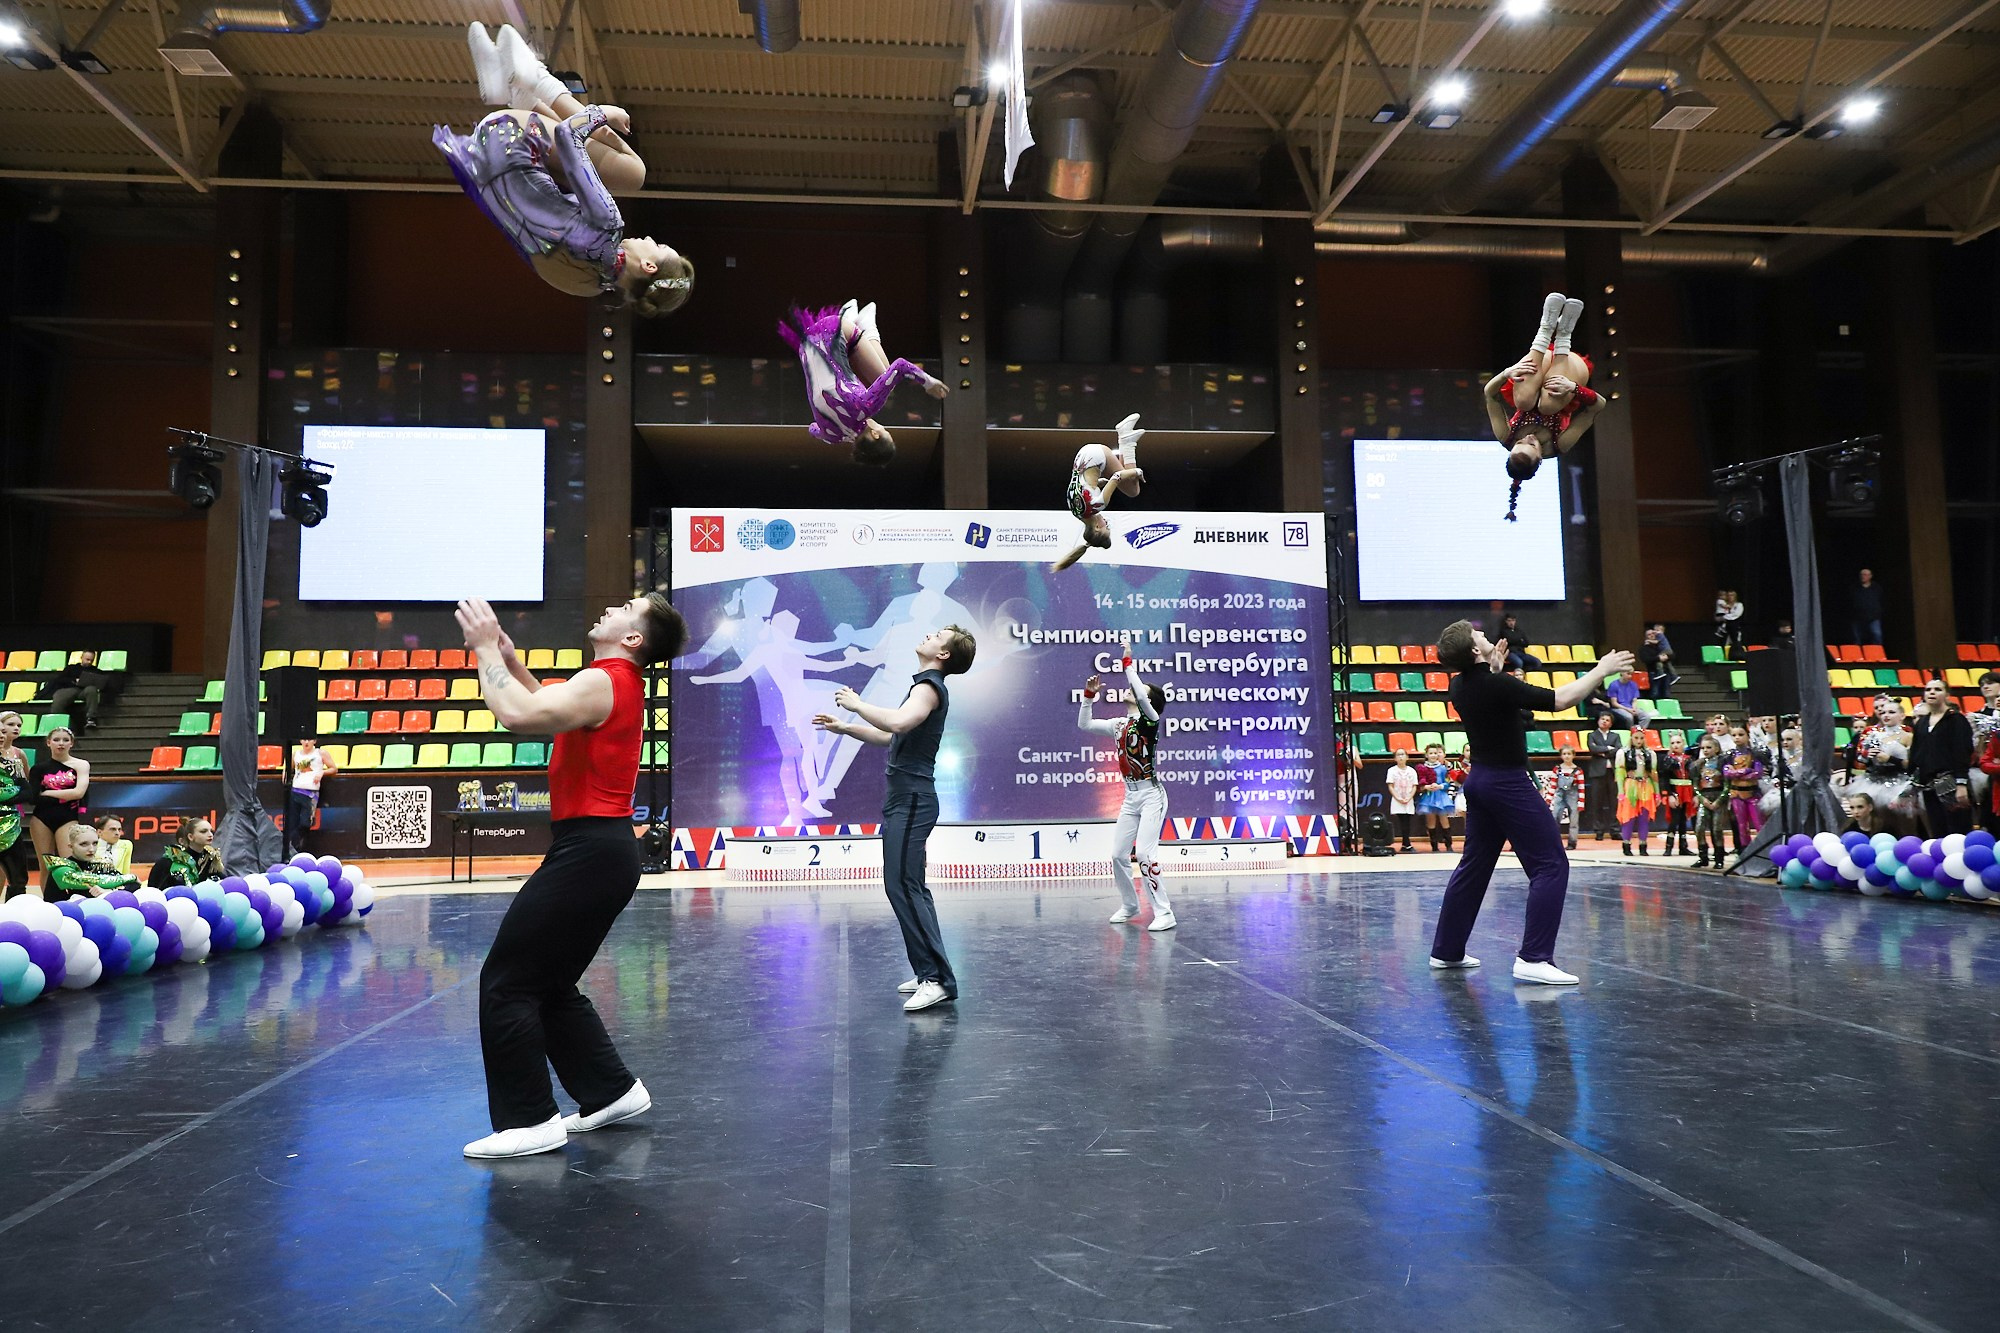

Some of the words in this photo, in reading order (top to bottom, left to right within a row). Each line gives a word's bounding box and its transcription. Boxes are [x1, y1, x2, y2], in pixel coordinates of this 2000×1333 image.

[996, 534, 1058, 543] ФЕДЕРАЦИЯ
[1193, 531, 1269, 543] ДНЕВНИК
[1287, 527, 1304, 542] 78
[1093, 593, 1114, 608] 14
[1127, 593, 1145, 608] 15
[1149, 594, 1220, 612] октября
[1223, 593, 1265, 608] 2023
[1268, 597, 1306, 611] года
[1012, 623, 1144, 644] Чемпионат
[1150, 628, 1163, 643] и
[1169, 622, 1308, 648] Первенство
[1105, 683, 1310, 705] акбатическому
[1165, 714, 1311, 737] рок-н-роллу
[1220, 744, 1314, 764] фестиваль
[1015, 773, 1038, 784] по
[1042, 768, 1200, 788] акробатикому
[1204, 768, 1315, 785] рок-н-роллу
[1214, 791, 1226, 801] и
[1229, 787, 1315, 805] буги-вуги
[473, 827, 526, 837] Петербурга
[1030, 830, 1042, 859] 1
[1220, 846, 1229, 861] 3
[808, 844, 821, 865] 2
